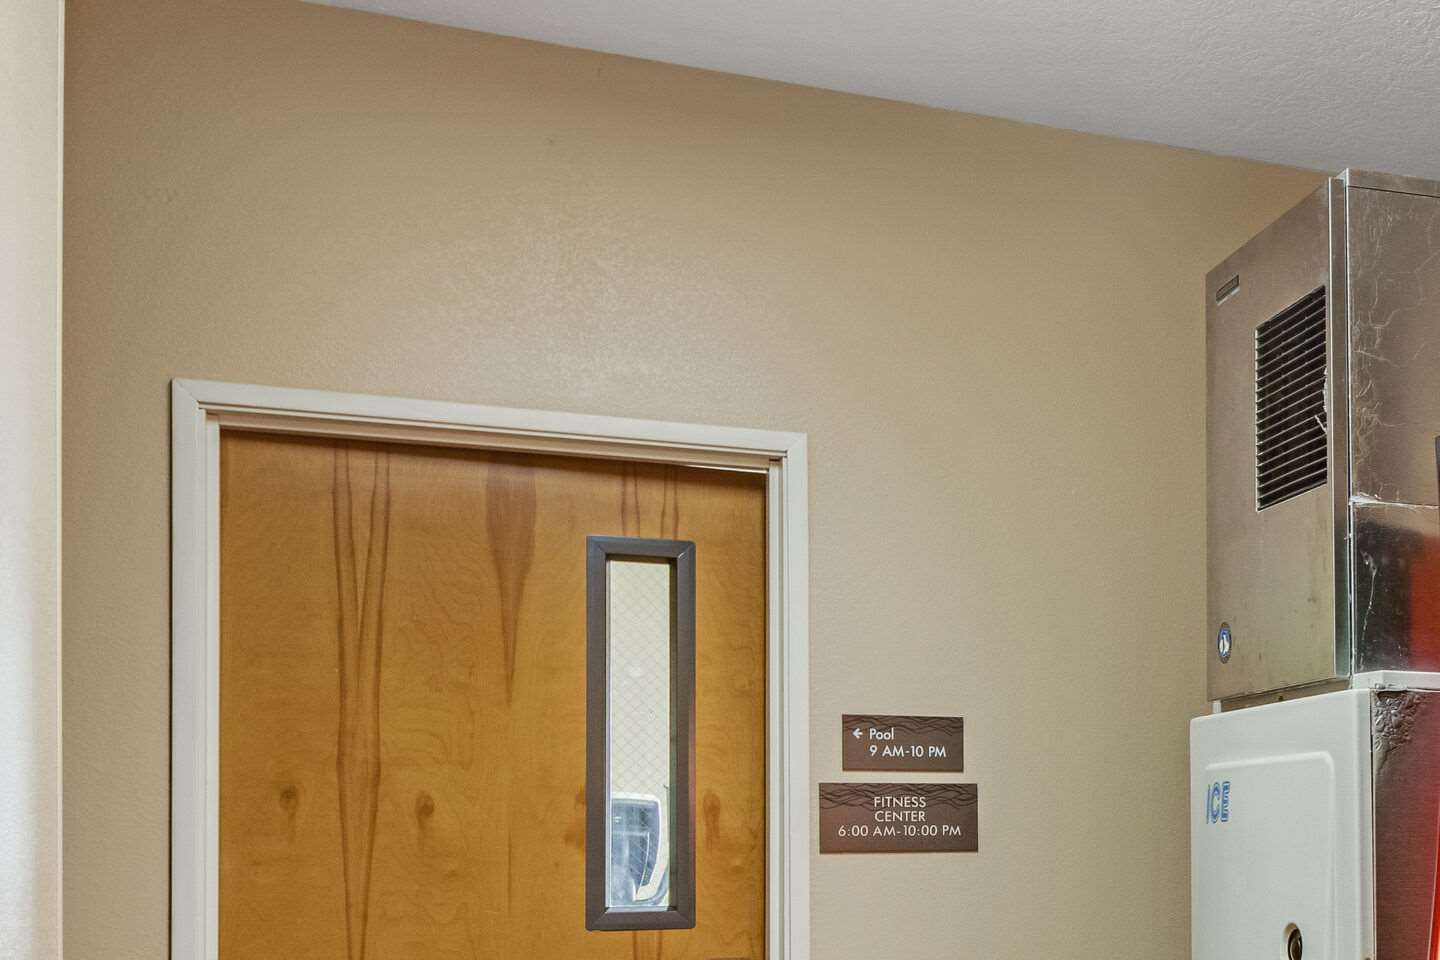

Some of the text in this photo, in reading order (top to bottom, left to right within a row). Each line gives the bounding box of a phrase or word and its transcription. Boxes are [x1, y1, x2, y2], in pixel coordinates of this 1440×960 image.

[869, 728, 895, 741] Pool
[869, 745, 947, 758] 9 AM-10 PM
[874, 796, 927, 808] FITNESS
[1206, 781, 1231, 824] ICE
[874, 810, 926, 822] CENTER
[838, 825, 961, 837] 6:00 AM-10:00 PM
